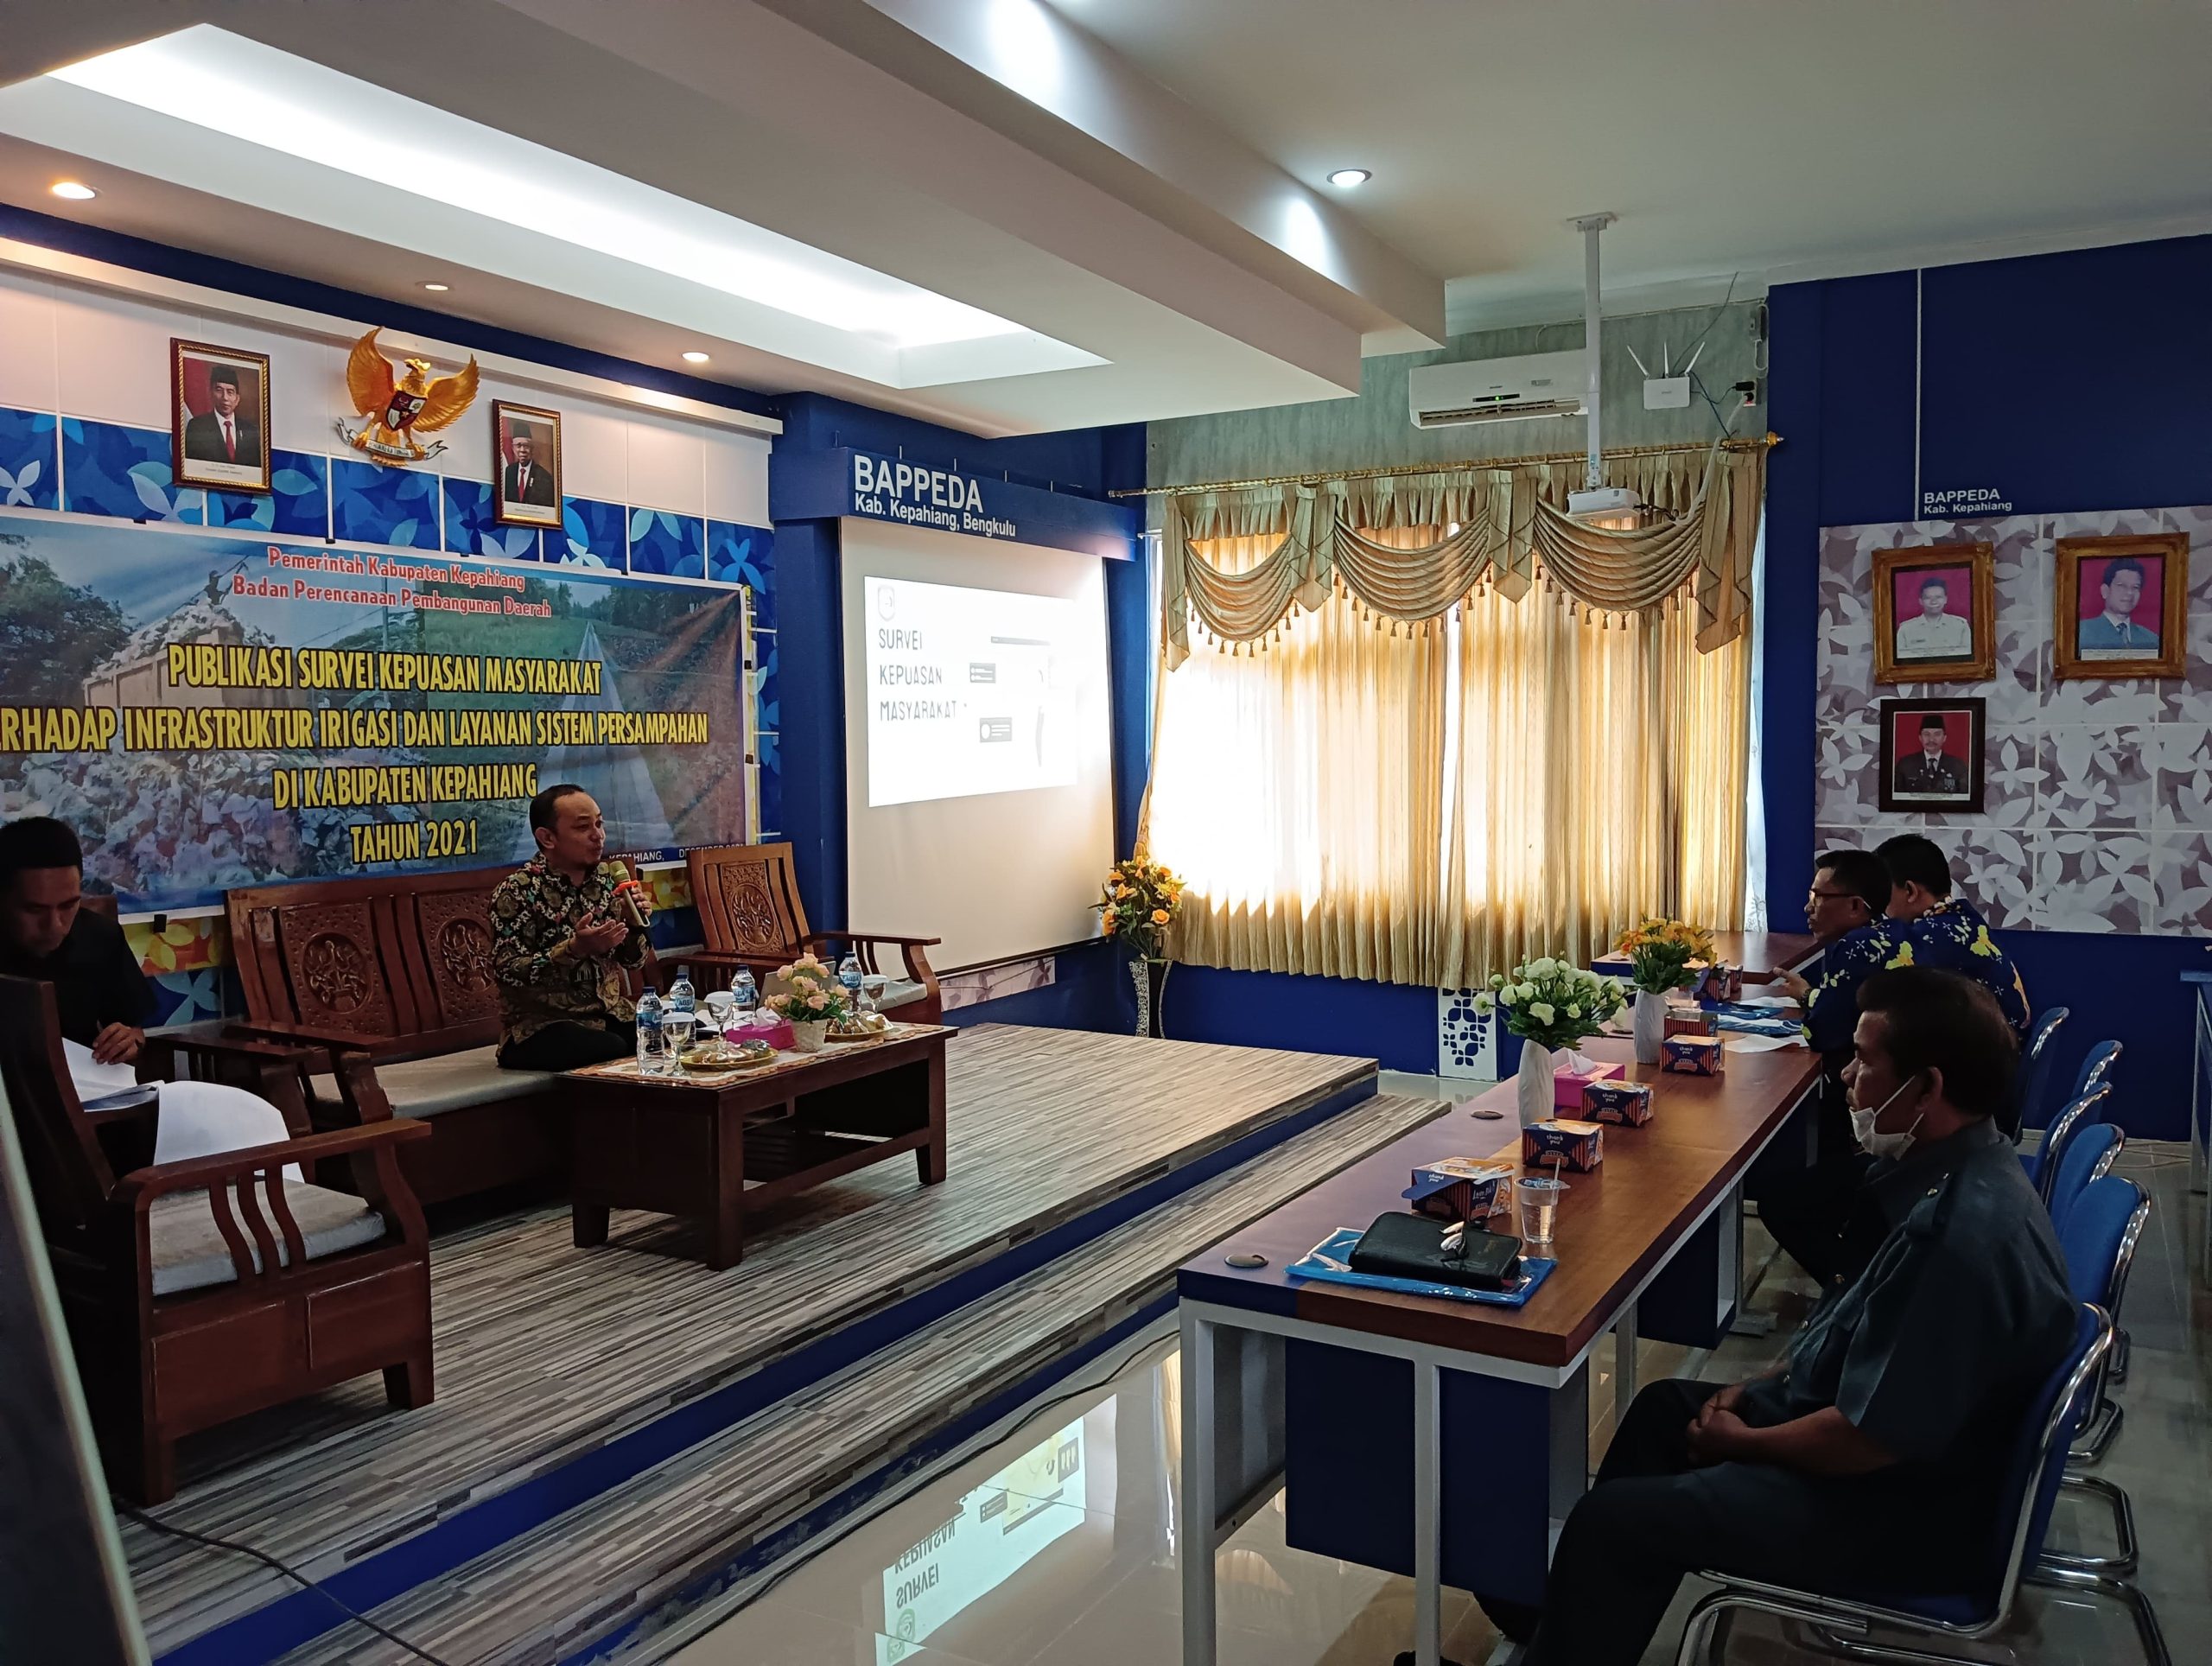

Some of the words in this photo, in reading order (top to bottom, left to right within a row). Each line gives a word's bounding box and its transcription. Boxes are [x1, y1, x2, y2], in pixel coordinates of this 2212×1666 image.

[855, 455, 983, 512] BAPPEDA
[1924, 488, 2000, 504] BAPPEDA
[855, 493, 886, 515] Kab.
[890, 499, 960, 531] Kepahiang,
[963, 512, 1016, 537] Bengkulu
[1924, 505, 1948, 514] Kab.
[1953, 502, 2012, 513] Kepahiang
[268, 546, 364, 575] Pemerintah
[368, 556, 448, 582] Kabupaten
[449, 564, 524, 593] Kepahiang
[232, 575, 289, 598] Badan
[294, 579, 397, 606] Perencanaan
[401, 588, 501, 615] Pembangunan
[504, 596, 552, 617] Daerah
[878, 628, 923, 651] SURVEI
[168, 644, 291, 688] PUBLIKASI
[298, 650, 374, 690] SURVEI
[378, 652, 480, 692] KEPUASAN
[486, 658, 601, 695] MASYARAKAT
[879, 664, 943, 686] KEPUASAN
[0, 706, 117, 752] RHADAP
[122, 707, 314, 751] INFRASTRUKTUR
[319, 709, 398, 748] IRIGASI
[404, 710, 445, 747] DAN
[449, 711, 532, 747] LAYANAN
[537, 712, 594, 746] SISTEM
[598, 713, 708, 744] PERSAMPAHAN
[880, 700, 957, 722] MASYARAKAT
[272, 769, 299, 810] DI
[305, 767, 427, 808] KABUPATEN
[431, 764, 537, 802] KEPAHIANG
[351, 823, 423, 863] TAHUN
[426, 819, 477, 859] 2021
